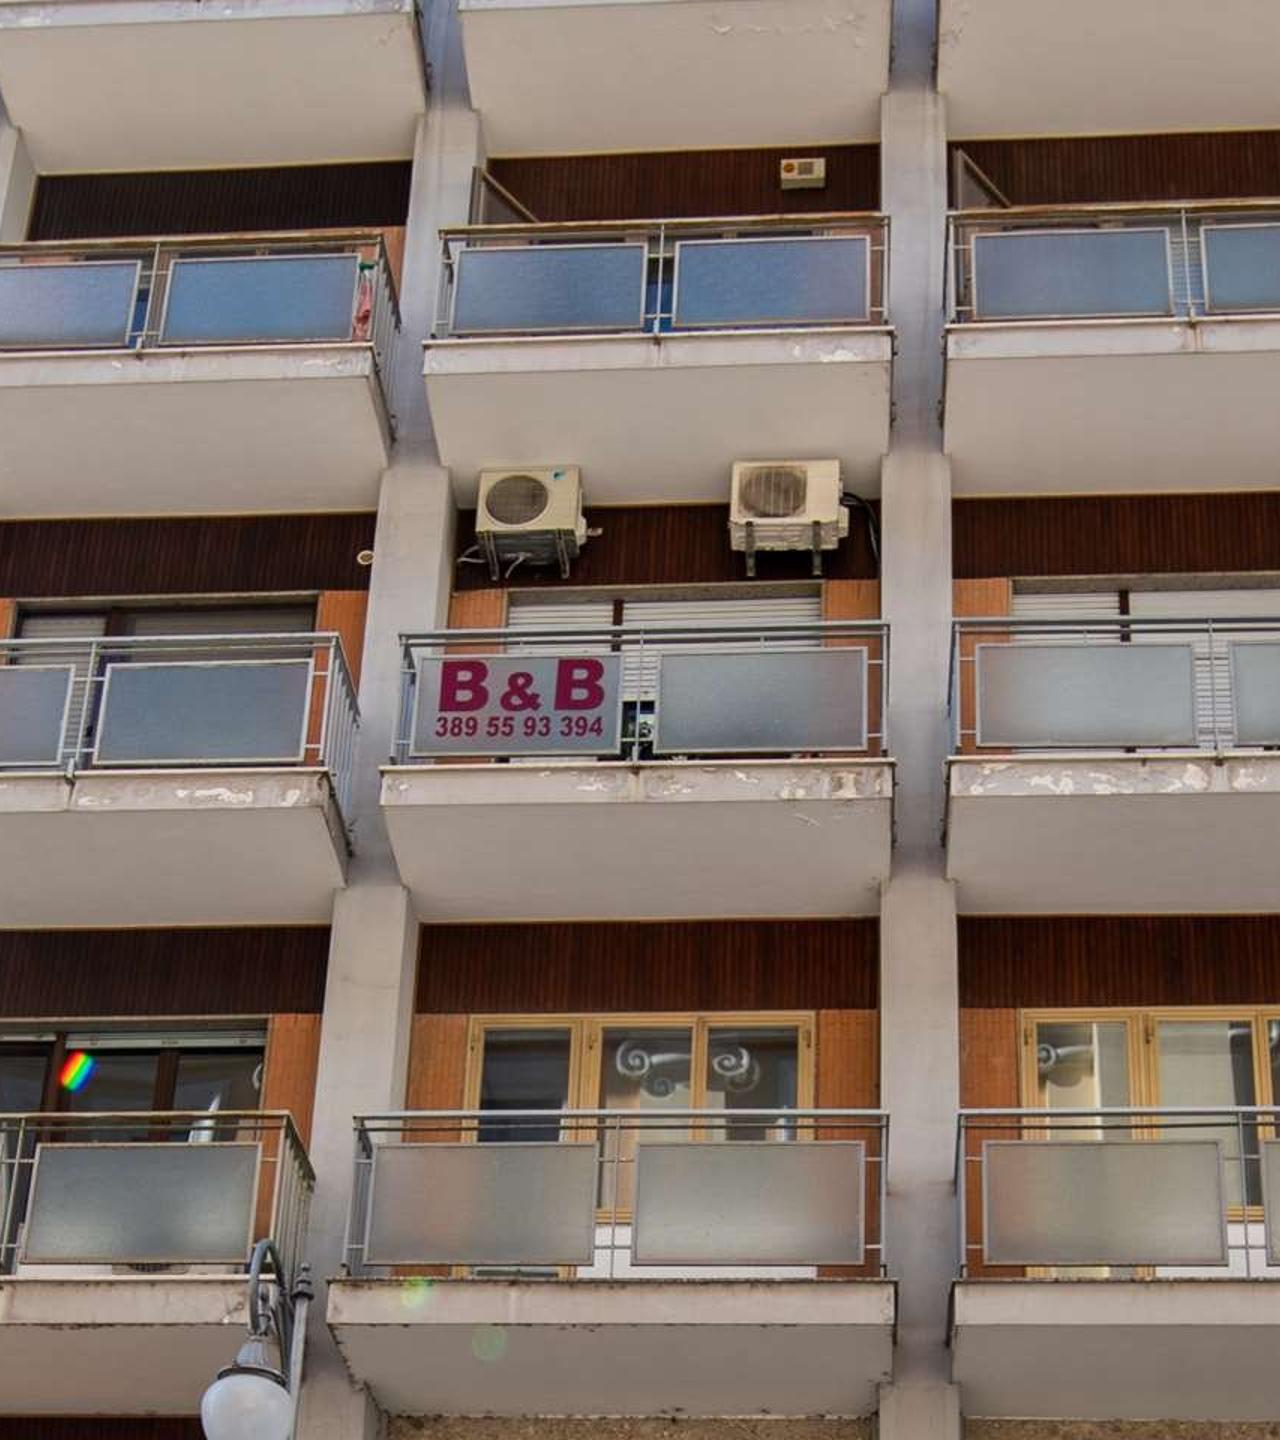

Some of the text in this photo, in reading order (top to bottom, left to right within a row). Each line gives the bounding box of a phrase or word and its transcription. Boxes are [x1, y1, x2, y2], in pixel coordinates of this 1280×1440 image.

[435, 716, 604, 737] 389 55 93 394
